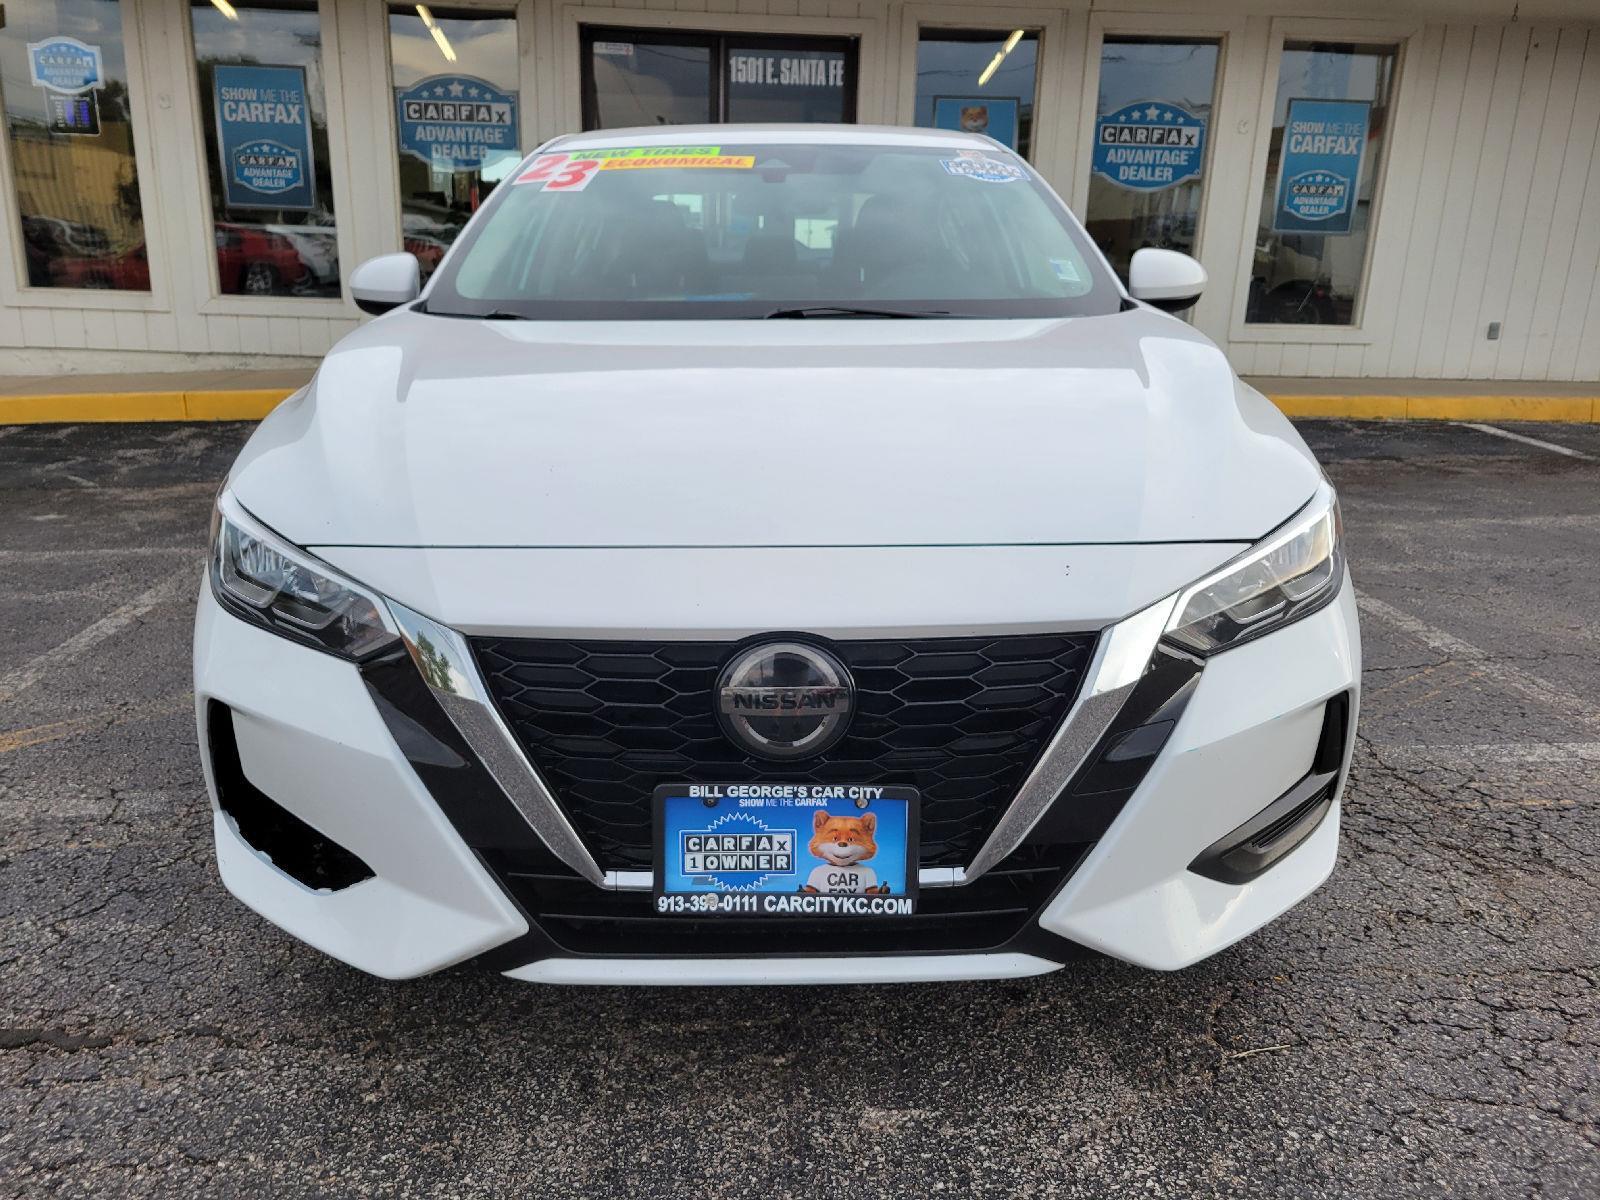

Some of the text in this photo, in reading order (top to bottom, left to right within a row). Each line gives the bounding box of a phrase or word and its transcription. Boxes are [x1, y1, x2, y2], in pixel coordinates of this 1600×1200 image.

[730, 56, 844, 87] 1501 E. SANTA FE
[221, 86, 301, 102] SHOW ME THE
[223, 101, 302, 125] CARFAX
[406, 102, 509, 124] CARFAX
[415, 125, 504, 144] ADVANTAGE
[1292, 121, 1364, 135] SHOW ME THE
[1101, 126, 1198, 147] CARFAX
[431, 143, 488, 160] DEALER
[575, 147, 711, 161] NEW TIRES
[1289, 136, 1361, 156] CARFAX
[604, 157, 748, 169] ECONOMICAL
[1106, 148, 1189, 166] ADVANTAGE
[244, 167, 293, 179] ADVANTAGE
[518, 154, 599, 189] 23
[1119, 166, 1173, 182] DEALER
[252, 177, 286, 189] DEALER
[1299, 204, 1330, 215] DEALER
[734, 693, 836, 710] NISSAN
[689, 785, 883, 799] BILL GEORGE'S CAR CITY
[739, 798, 764, 807] SHOW
[779, 799, 794, 807] THE
[795, 798, 828, 807] CARFAX
[687, 836, 789, 852] CARFAX
[827, 873, 859, 886] CAR
[764, 897, 913, 914] CARCITYKC.COM
